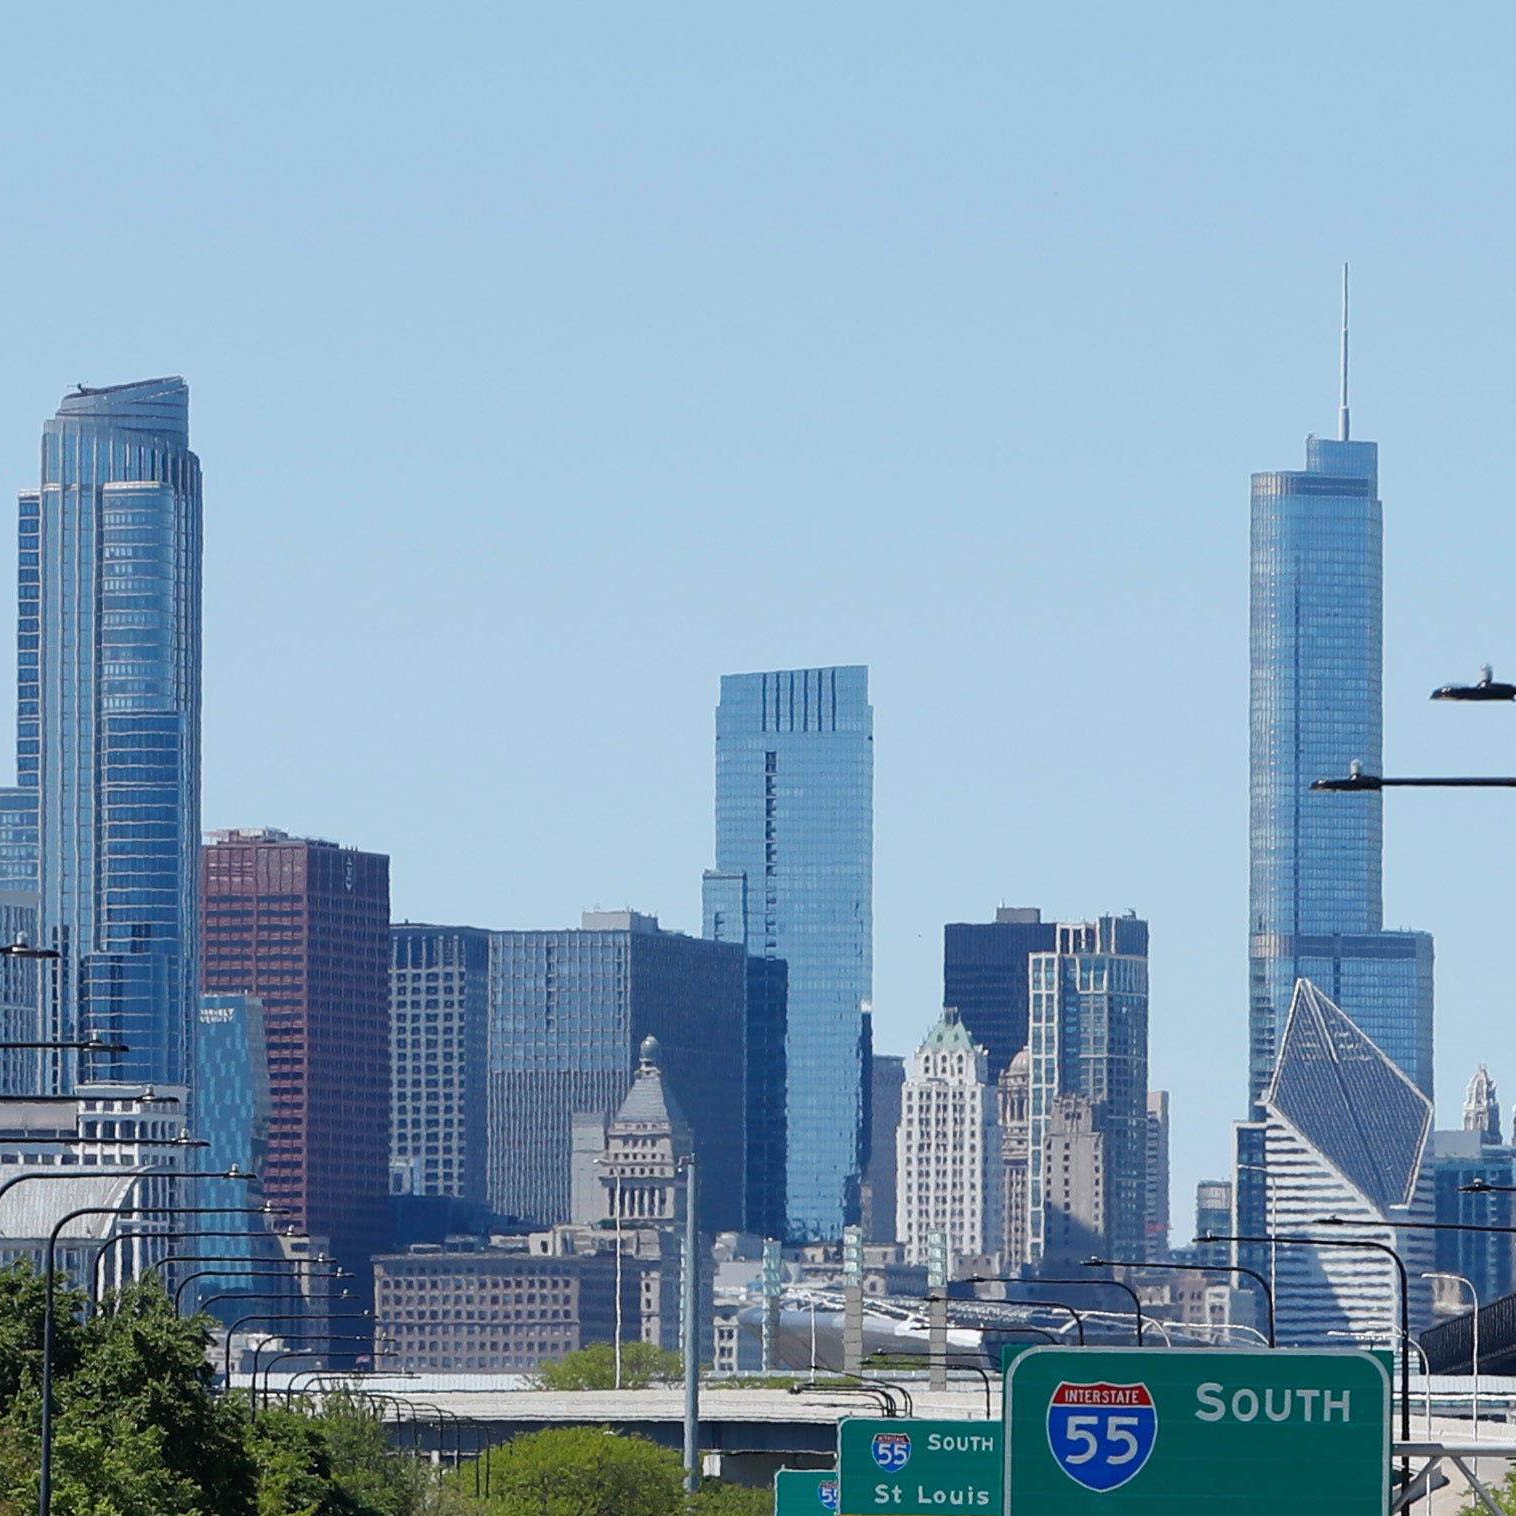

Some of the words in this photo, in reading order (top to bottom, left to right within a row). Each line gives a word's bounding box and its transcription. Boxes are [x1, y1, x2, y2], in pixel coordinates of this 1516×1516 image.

[1064, 1389, 1139, 1404] INTERSTATE
[1195, 1382, 1351, 1422] SOUTH
[927, 1433, 994, 1452] SOUTH
[1065, 1415, 1139, 1465] 55
[877, 1443, 908, 1465] 55
[874, 1484, 902, 1504] St
[918, 1486, 990, 1505] Louis
